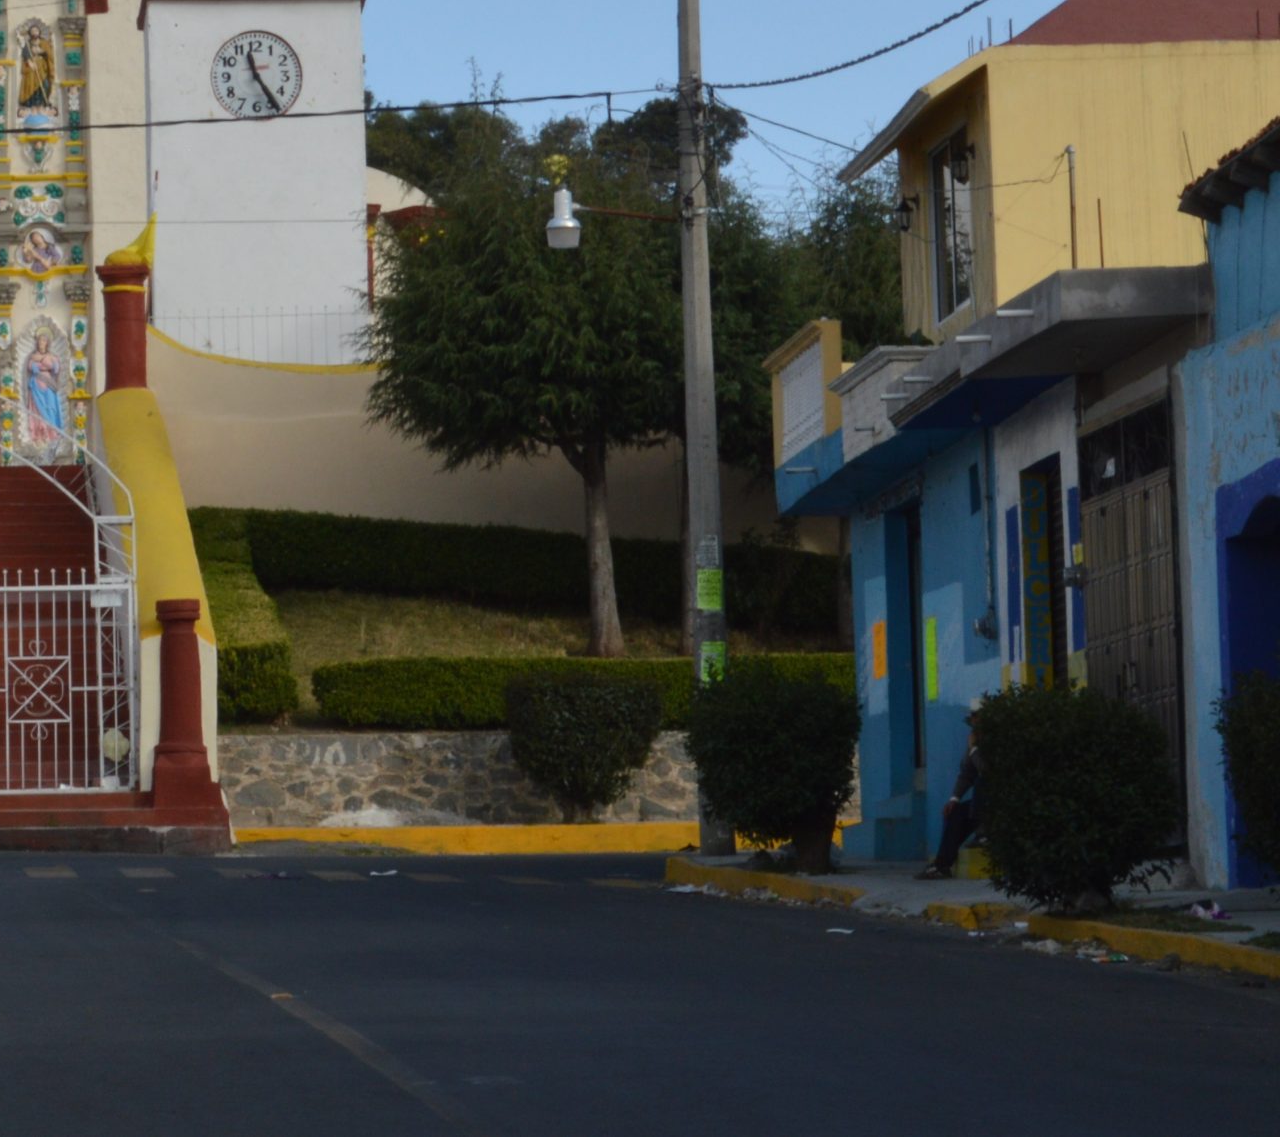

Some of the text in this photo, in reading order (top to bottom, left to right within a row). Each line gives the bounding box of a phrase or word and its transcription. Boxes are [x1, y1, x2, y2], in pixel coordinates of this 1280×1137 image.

[234, 44, 244, 55] 11
[247, 40, 262, 53] 12
[267, 44, 273, 56] 1
[221, 55, 237, 68] 10
[278, 54, 288, 67] 2
[221, 71, 231, 84] 9
[281, 70, 290, 83] 3
[226, 86, 235, 99] 8
[276, 86, 285, 96] 4
[238, 97, 247, 110] 7
[252, 100, 262, 113] 6
